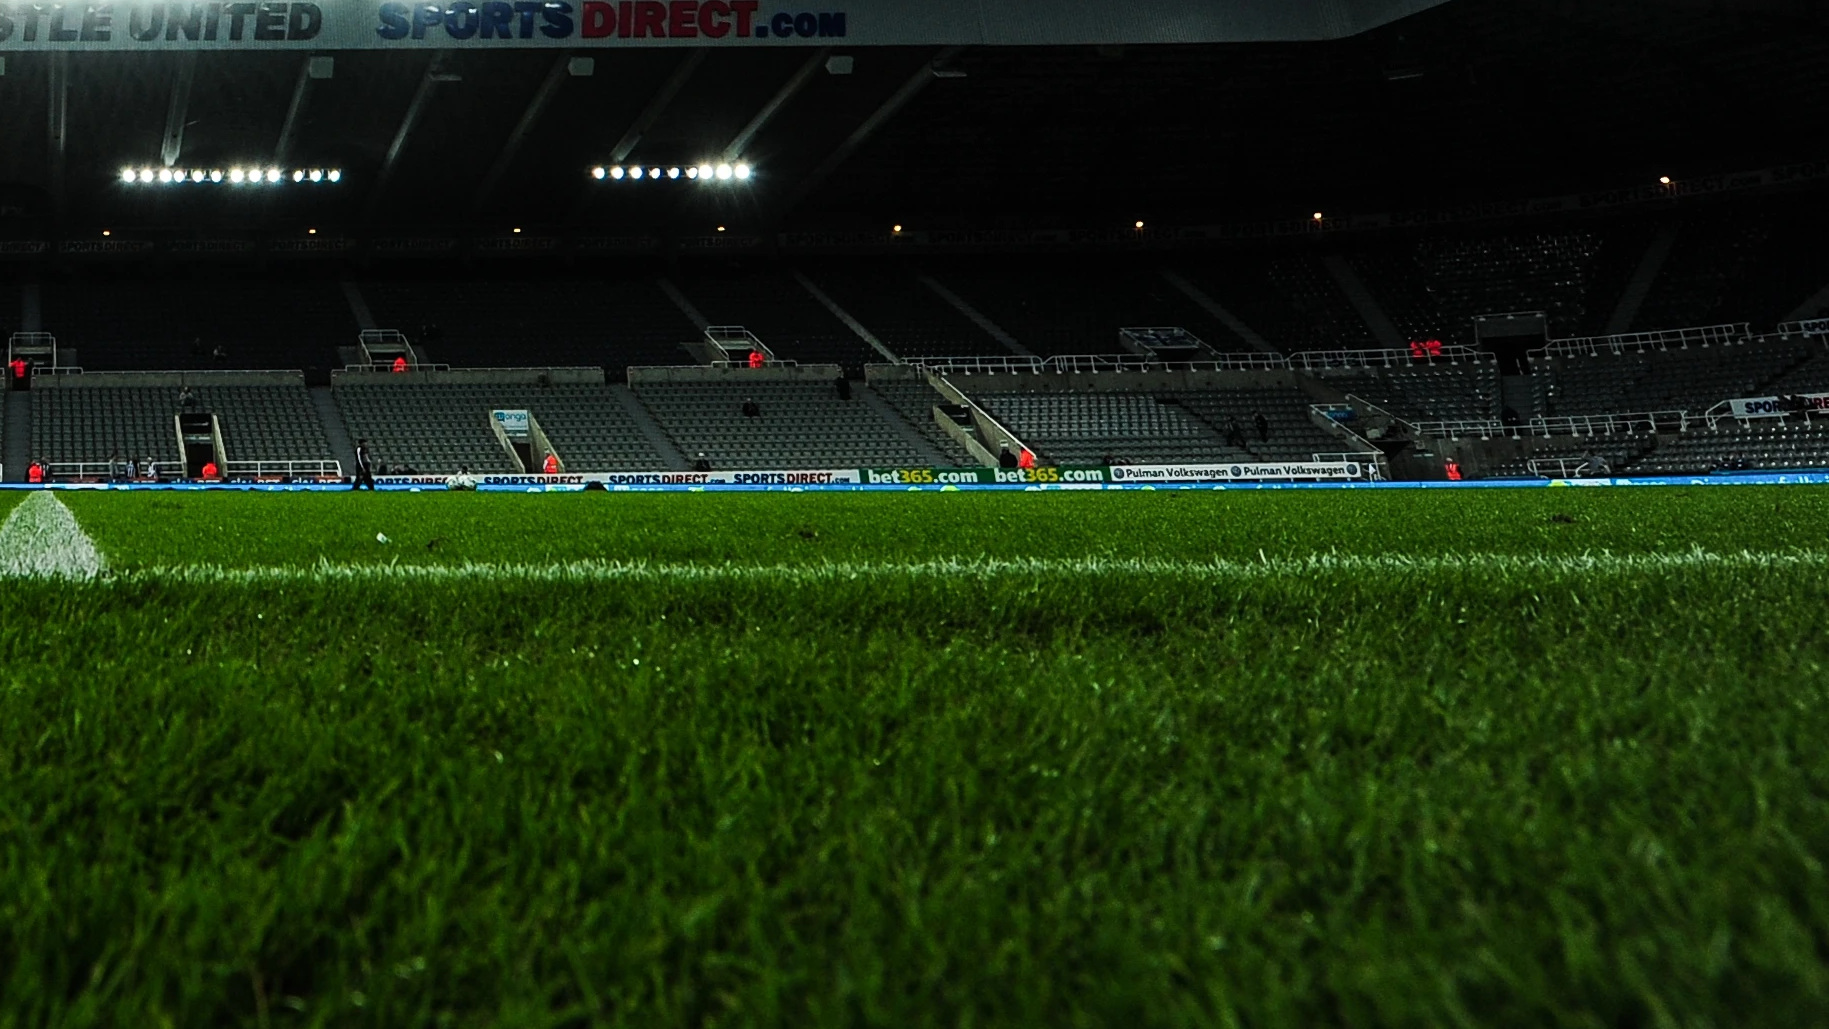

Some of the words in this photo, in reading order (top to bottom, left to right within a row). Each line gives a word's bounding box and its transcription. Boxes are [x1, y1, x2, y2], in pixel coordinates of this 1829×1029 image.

[128, 2, 322, 41] UNITED
[868, 469, 978, 483] bet365.com
[995, 468, 1103, 482] bet365.com
[1126, 468, 1164, 478] Pulman
[1166, 468, 1228, 479] Volkswagen
[1243, 467, 1281, 476] Pulman
[1283, 466, 1345, 477] Volkswagen
